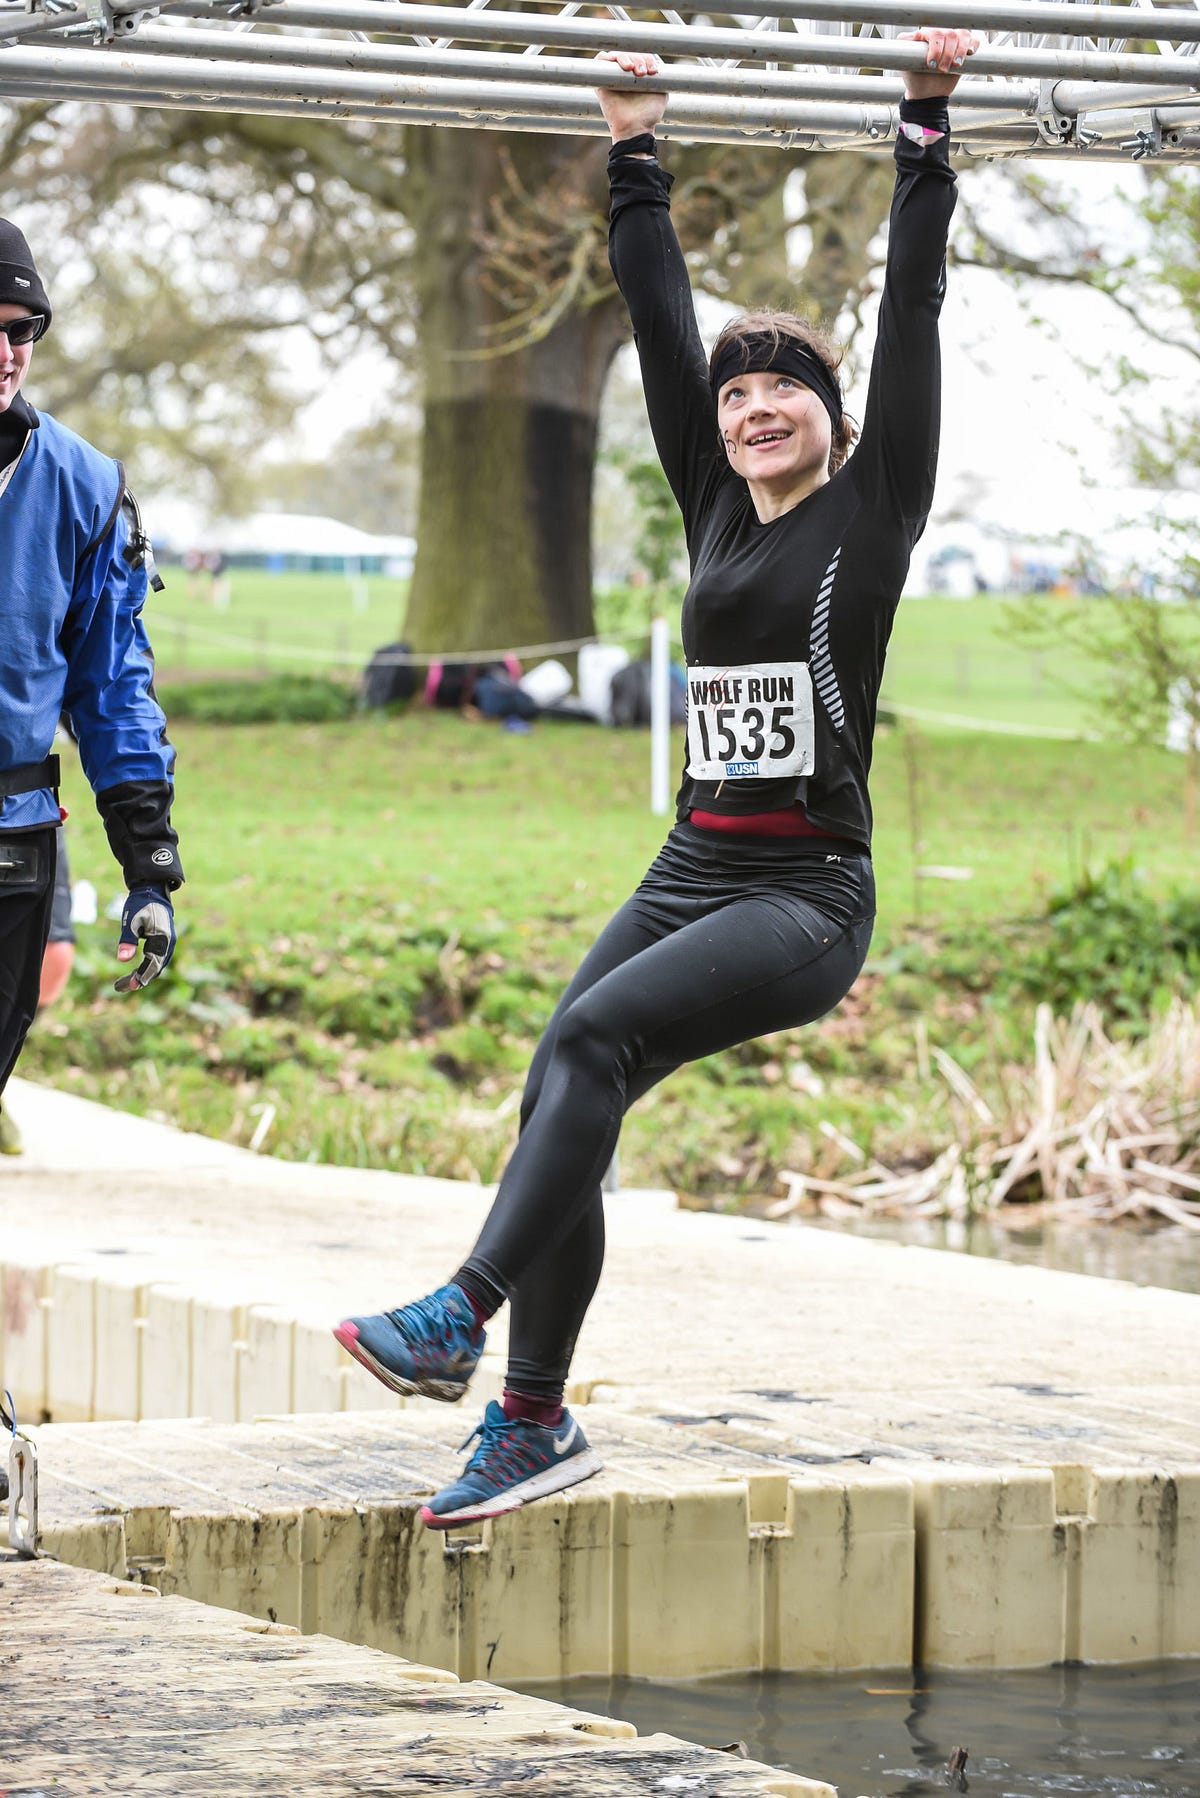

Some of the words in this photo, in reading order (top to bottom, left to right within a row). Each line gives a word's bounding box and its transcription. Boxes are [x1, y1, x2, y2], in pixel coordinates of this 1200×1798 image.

[690, 679, 742, 705] WOLF
[748, 677, 793, 703] RUN
[697, 706, 795, 761] 1535
[735, 763, 758, 775] USN
